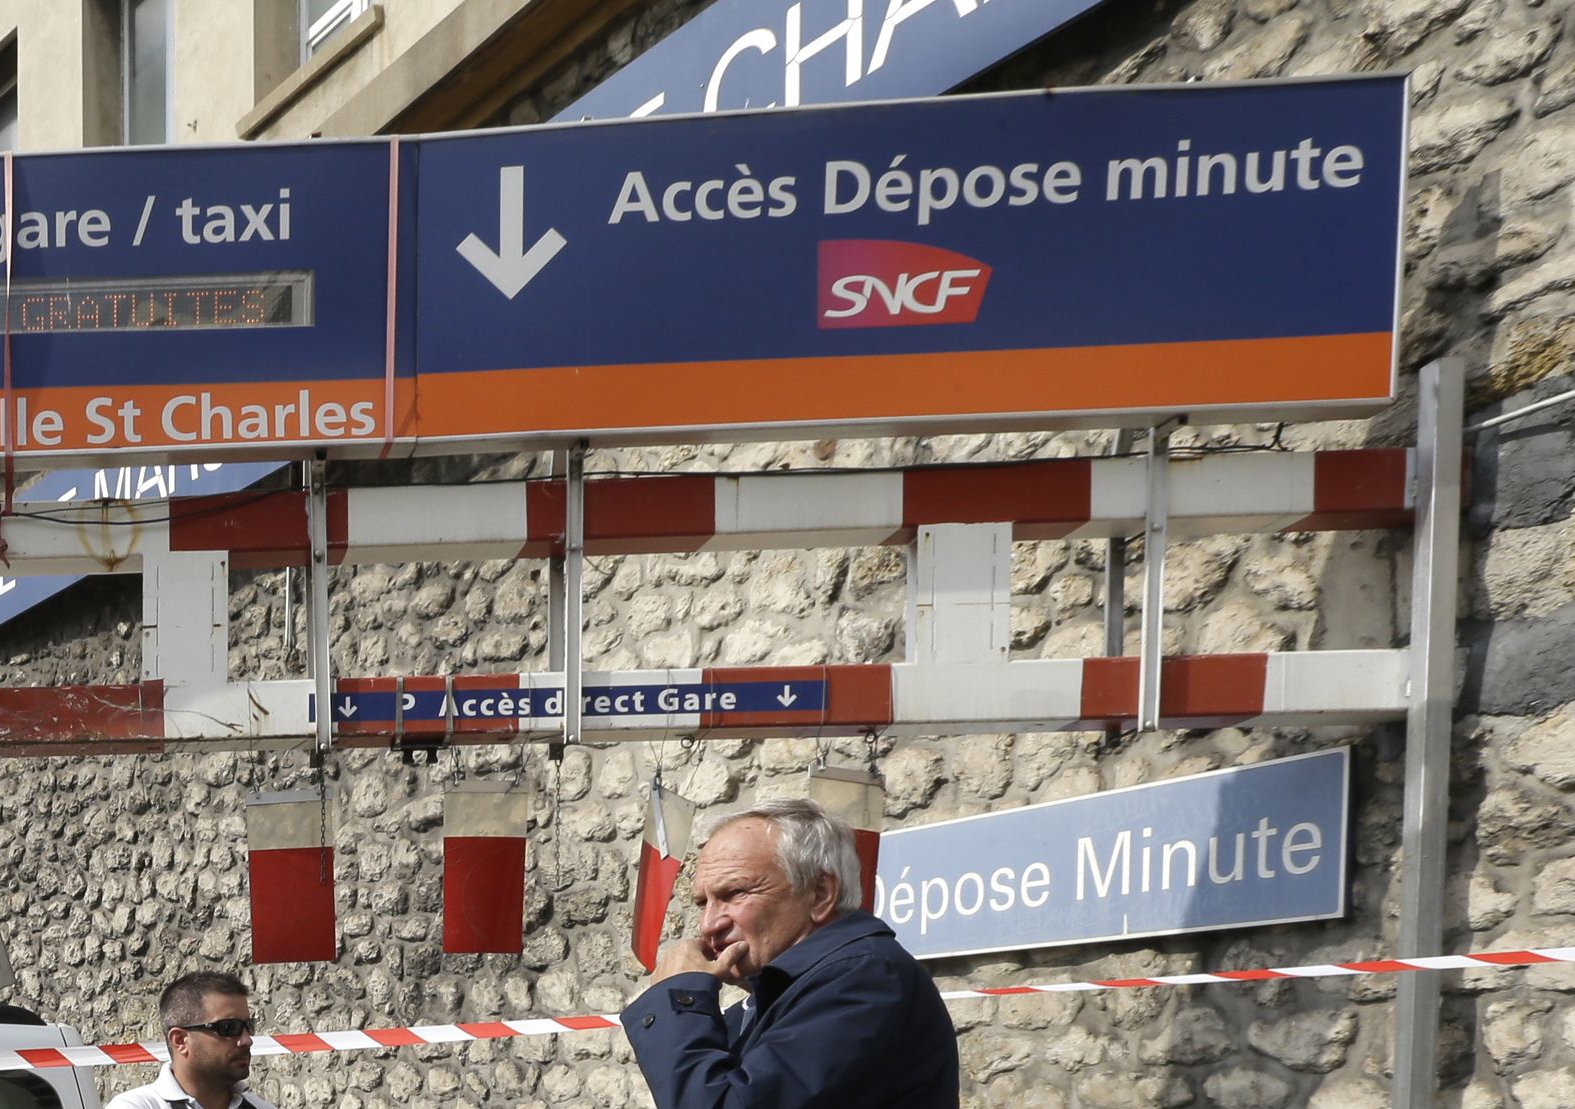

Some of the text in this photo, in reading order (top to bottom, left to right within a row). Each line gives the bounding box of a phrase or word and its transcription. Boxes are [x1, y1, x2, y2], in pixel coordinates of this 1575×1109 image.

[608, 137, 1363, 226] Accès Dépose minute
[175, 188, 291, 244] taxi
[22, 289, 264, 331] GRATUITES
[823, 267, 982, 319] SNCF
[85, 396, 142, 444] St
[161, 389, 376, 441] Charles
[438, 691, 532, 718] Accès
[544, 689, 645, 716] drect
[657, 687, 738, 712] Gare
[1075, 815, 1323, 901] Minute
